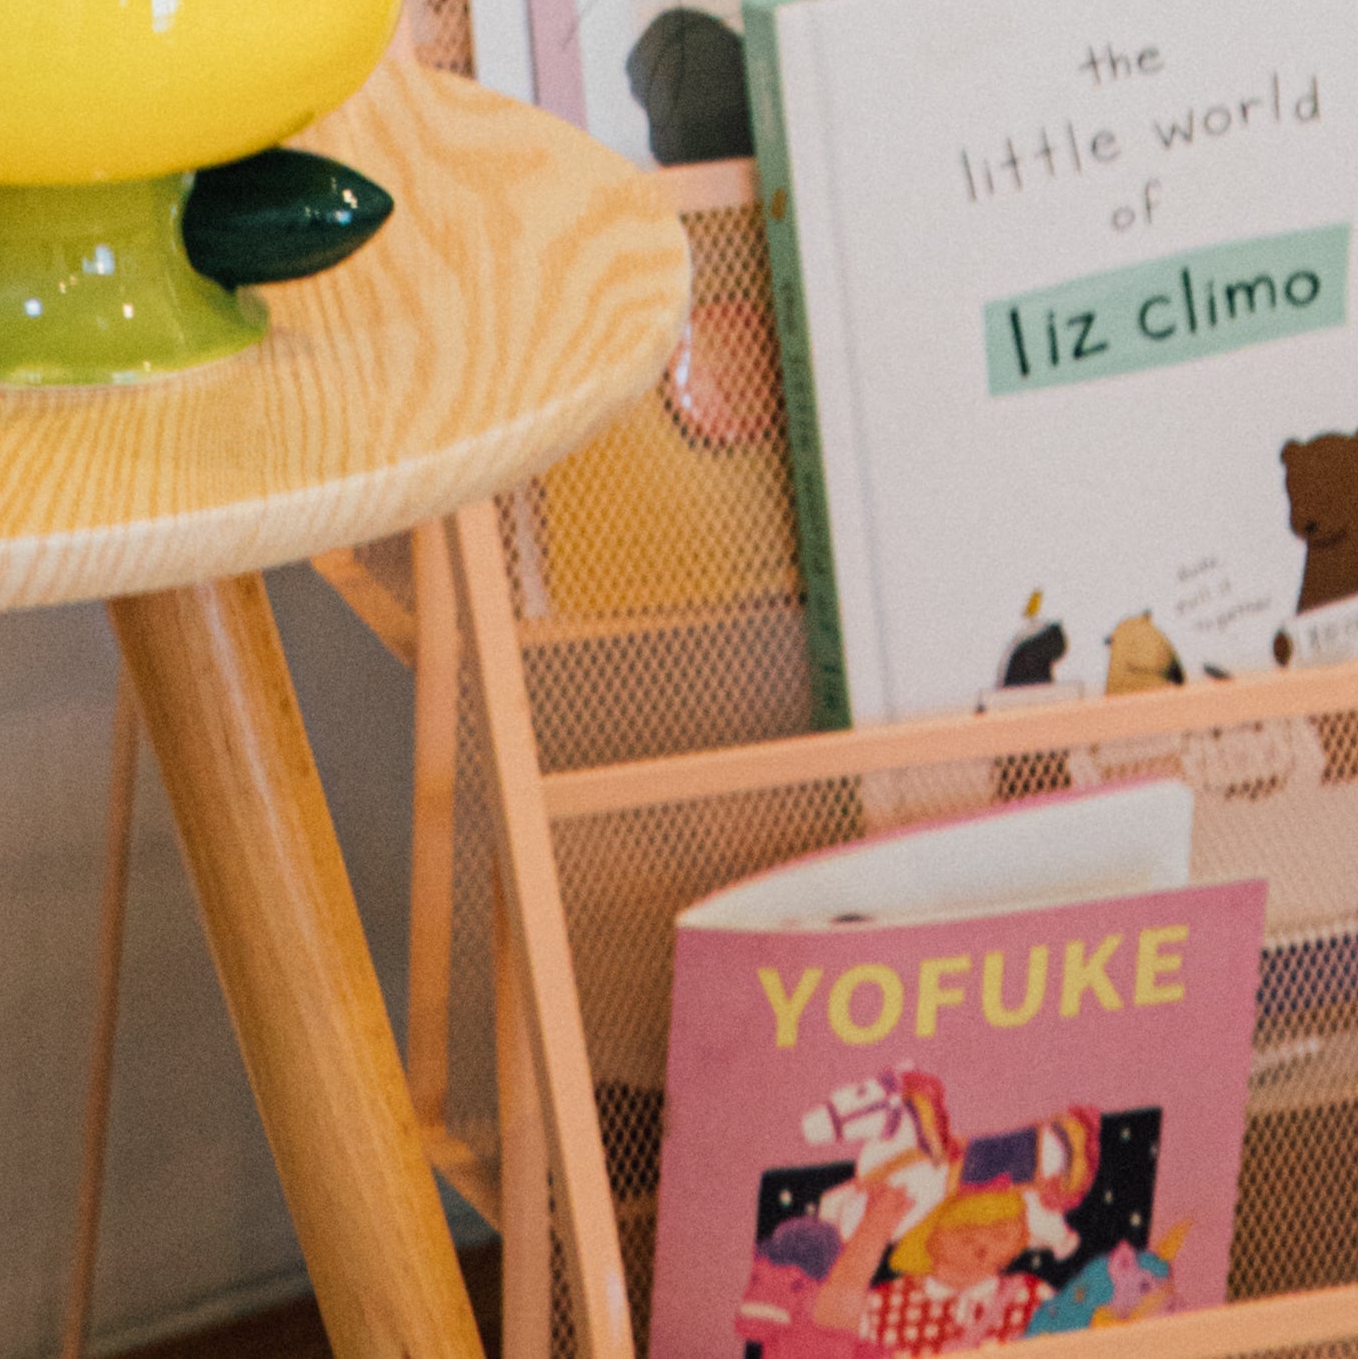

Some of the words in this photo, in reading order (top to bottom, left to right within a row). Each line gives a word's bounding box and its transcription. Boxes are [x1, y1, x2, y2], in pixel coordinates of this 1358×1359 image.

[1078, 41, 1167, 87] the
[957, 120, 1122, 204] little
[1154, 75, 1324, 153] world
[1109, 181, 1162, 234] of
[1006, 306, 1109, 378] liz
[1137, 265, 1323, 344] climo
[755, 924, 1191, 1049] YOFUKE
